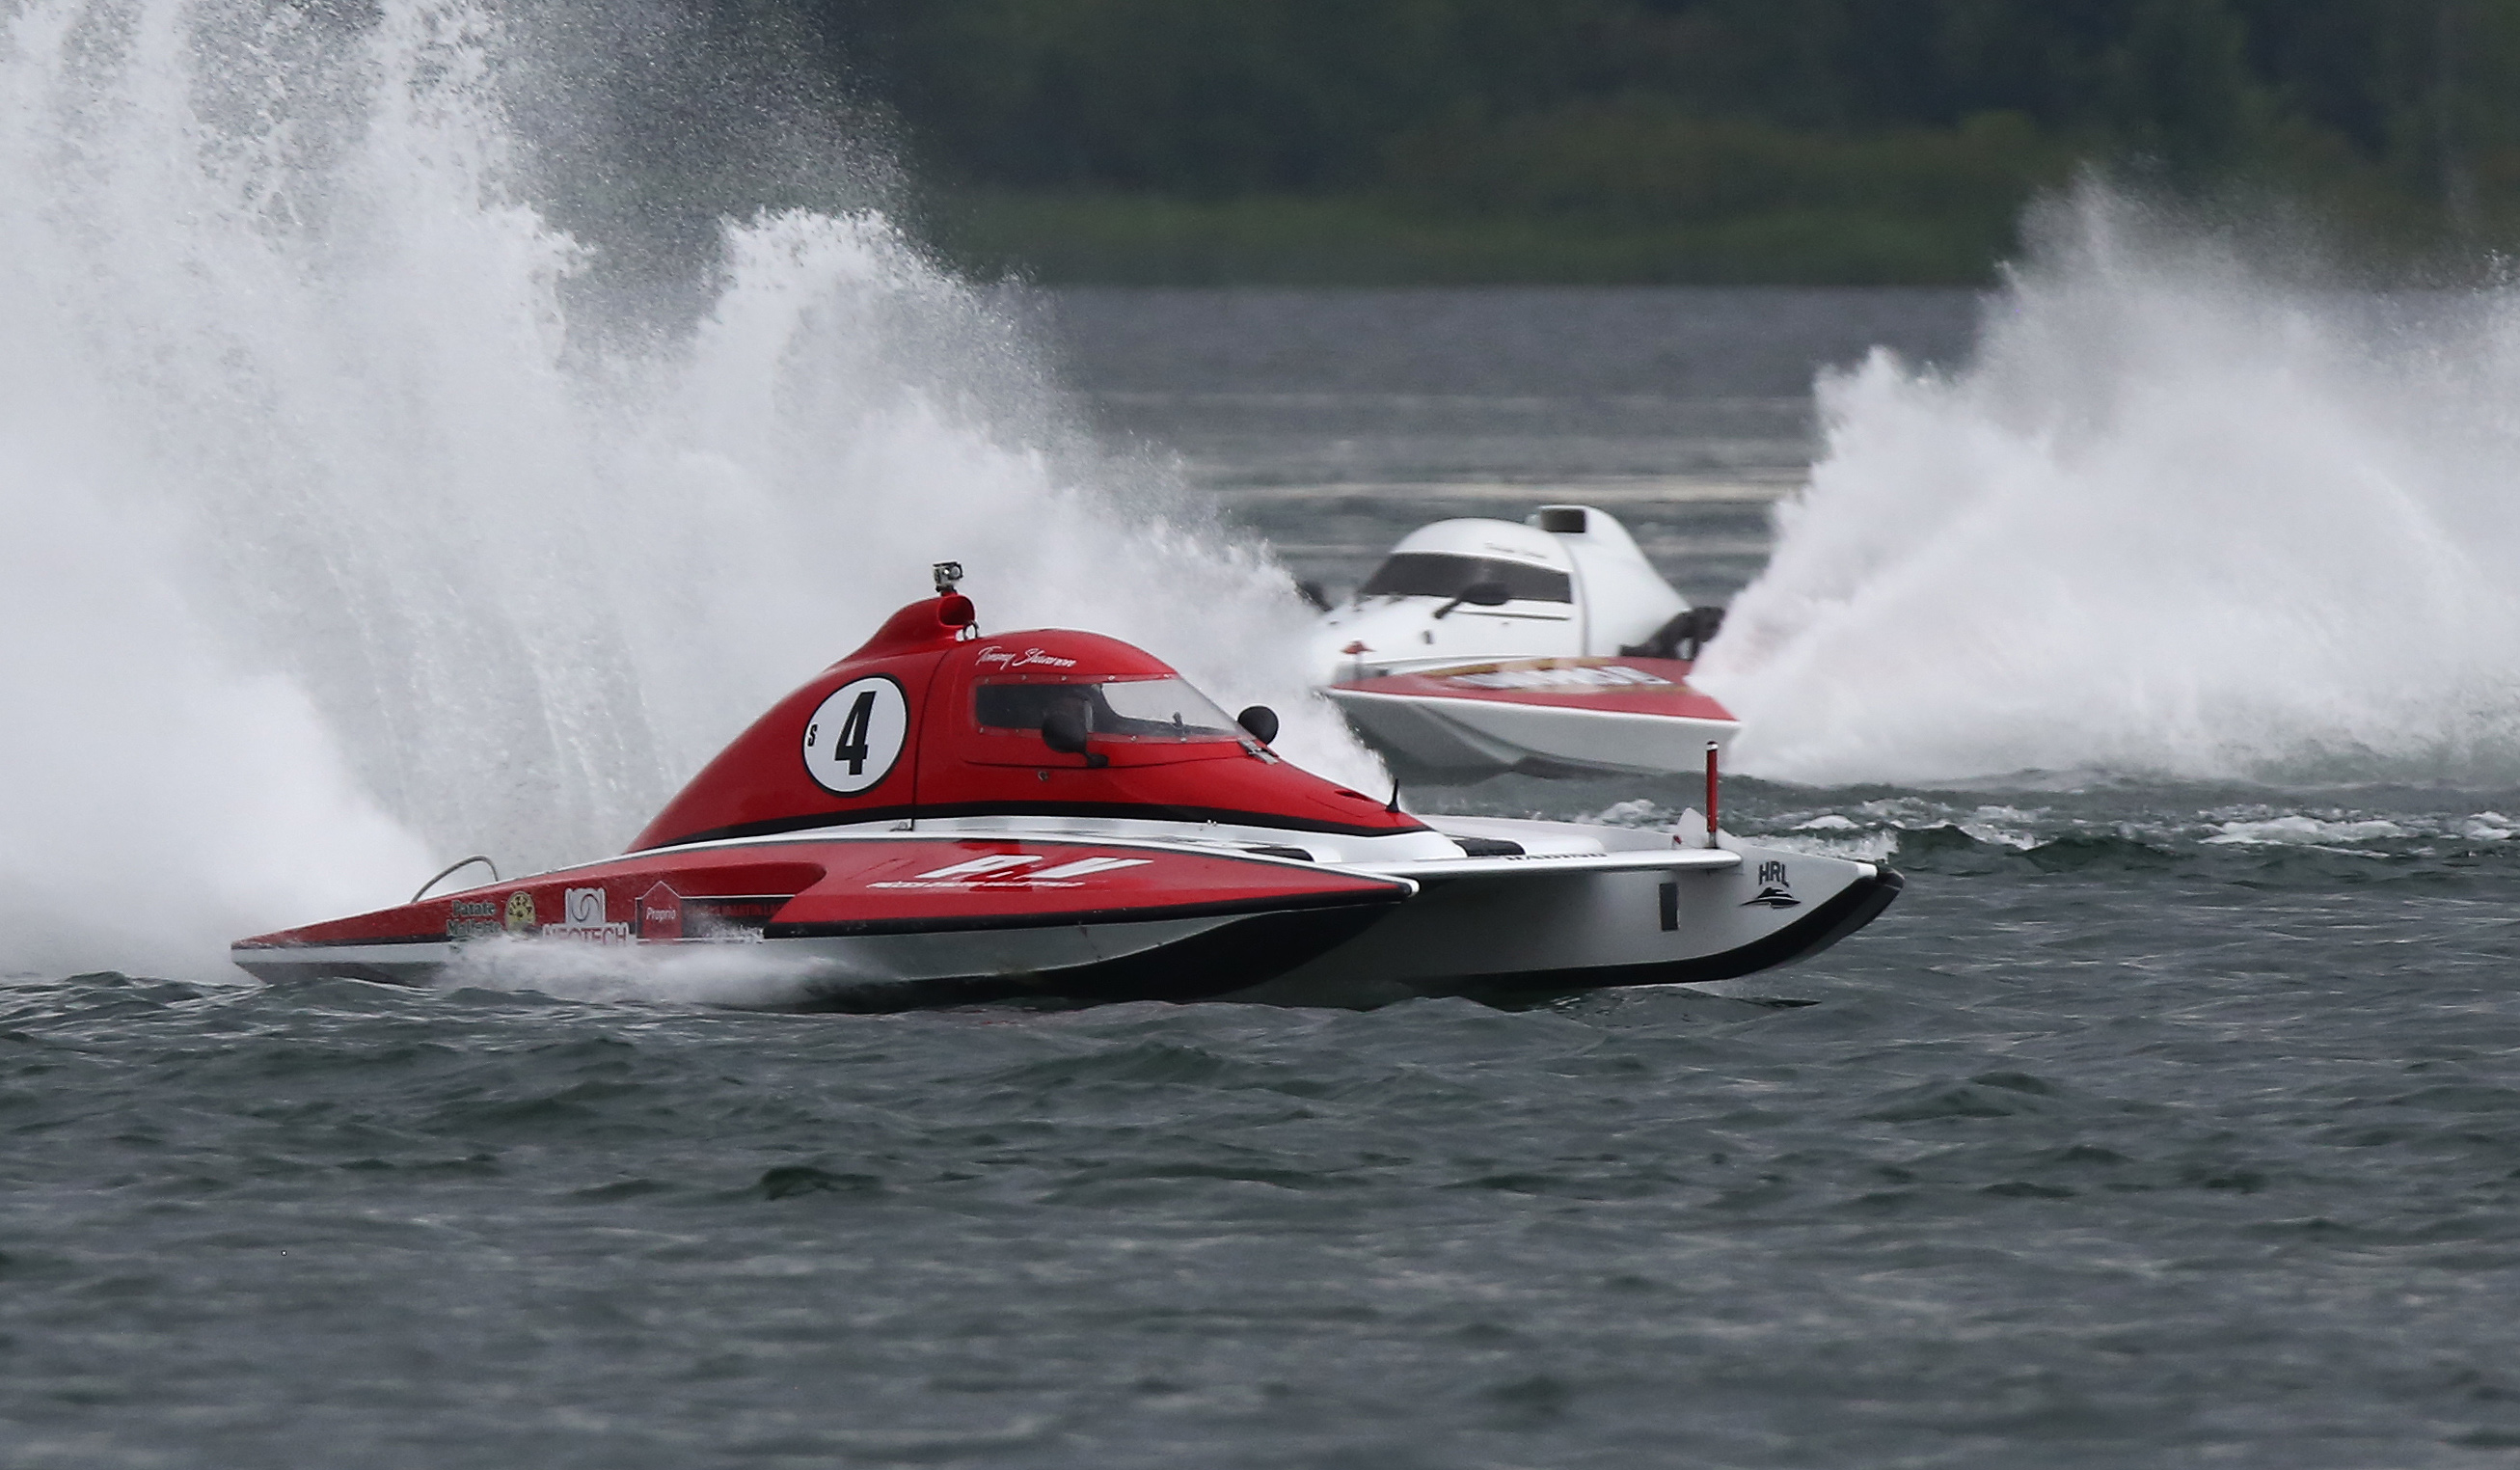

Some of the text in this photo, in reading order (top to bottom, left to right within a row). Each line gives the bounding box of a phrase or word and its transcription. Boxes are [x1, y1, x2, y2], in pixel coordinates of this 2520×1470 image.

[807, 691, 877, 776] S 4
[1759, 860, 1790, 888] HRL
